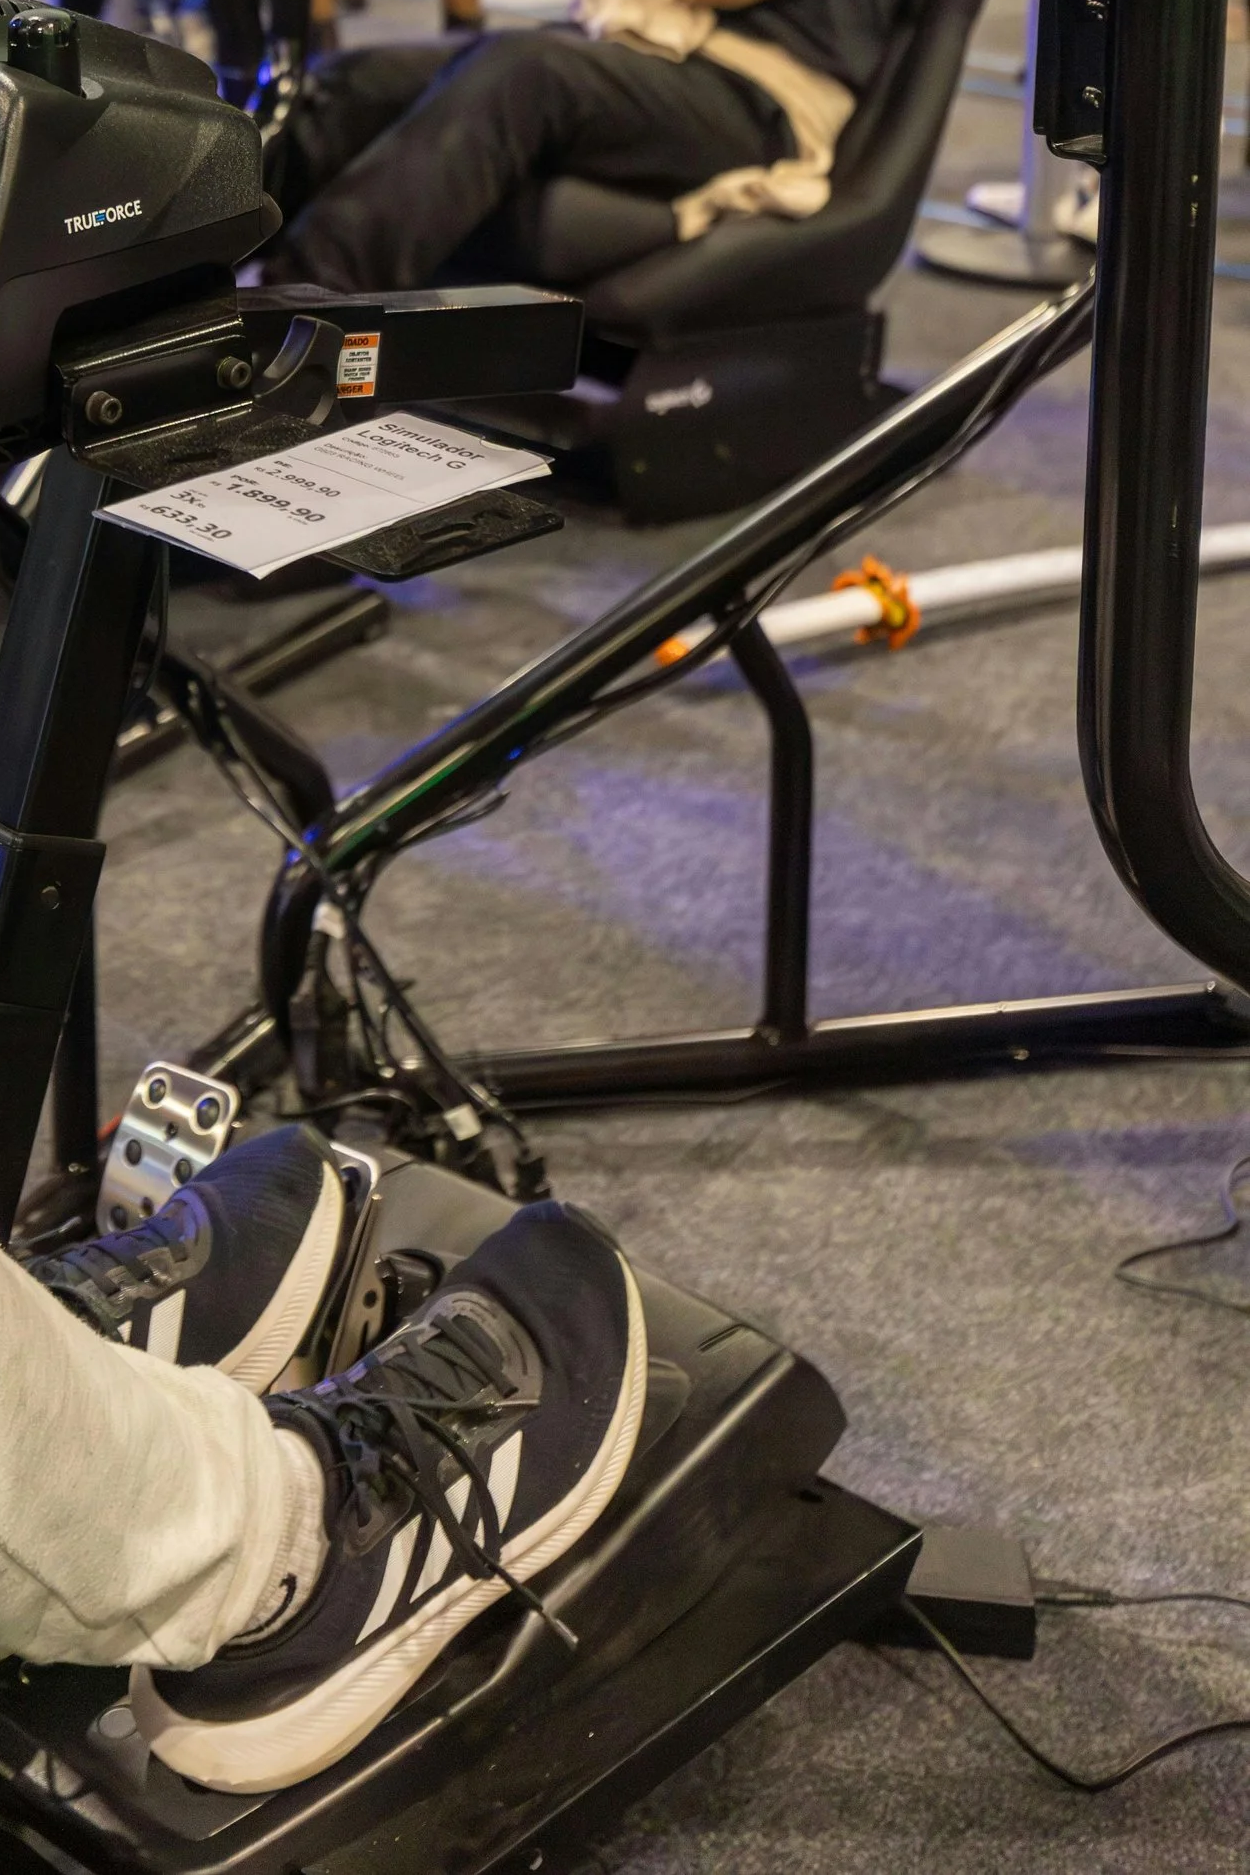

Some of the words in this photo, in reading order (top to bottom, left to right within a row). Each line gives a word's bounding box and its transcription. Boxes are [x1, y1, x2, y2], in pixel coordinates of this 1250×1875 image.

[64, 199, 143, 235] TRUEFORCE
[356, 429, 443, 462] Logitech
[446, 460, 467, 470] G
[378, 423, 485, 460] Simulador
[266, 468, 341, 498] 2.999,90
[226, 483, 326, 523] 1.899,90
[150, 505, 232, 539] 633,30
